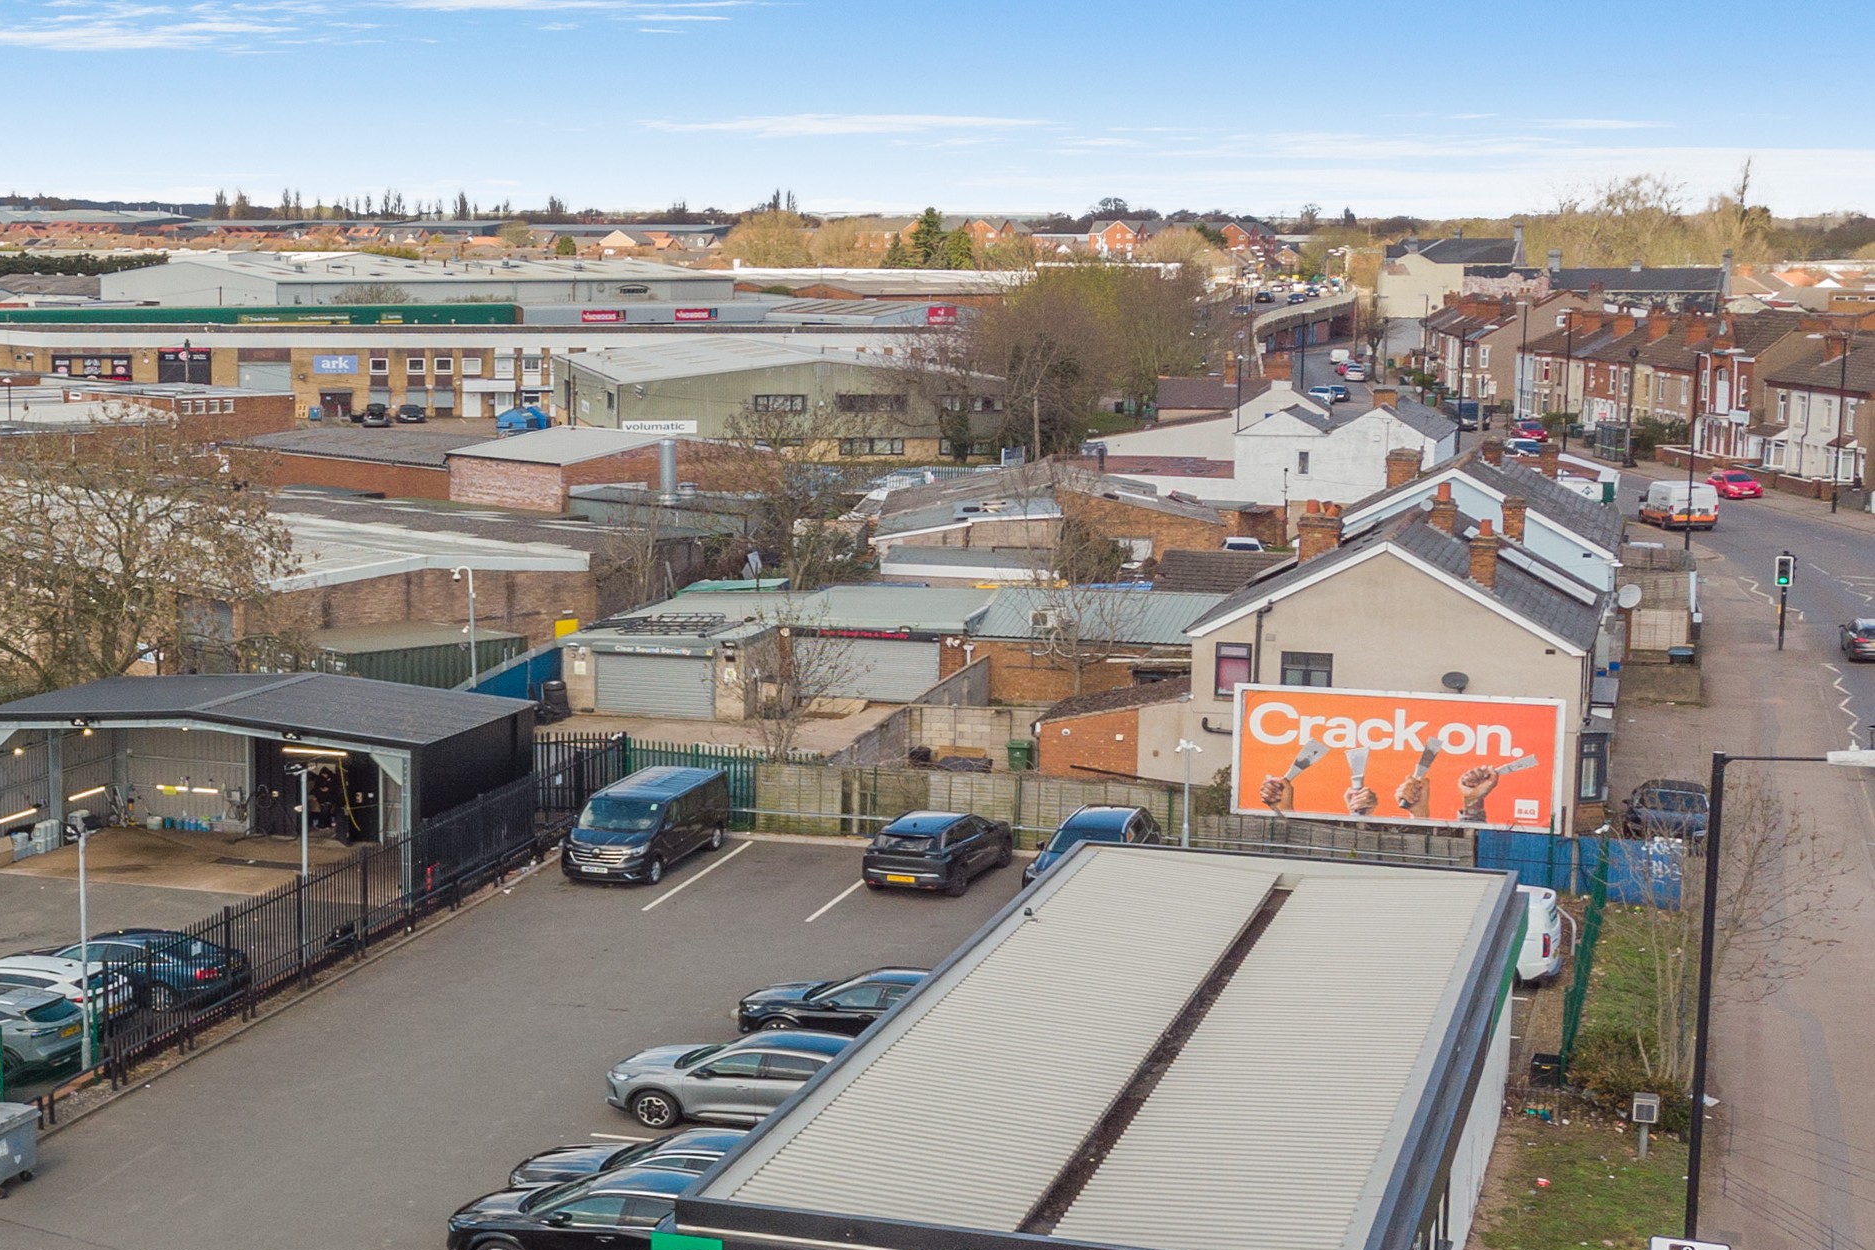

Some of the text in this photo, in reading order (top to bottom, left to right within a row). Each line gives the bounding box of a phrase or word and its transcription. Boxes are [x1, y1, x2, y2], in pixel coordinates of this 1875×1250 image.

[321, 356, 350, 369] ark
[625, 422, 685, 431] volumatic
[1249, 702, 1524, 758] Crack on.
